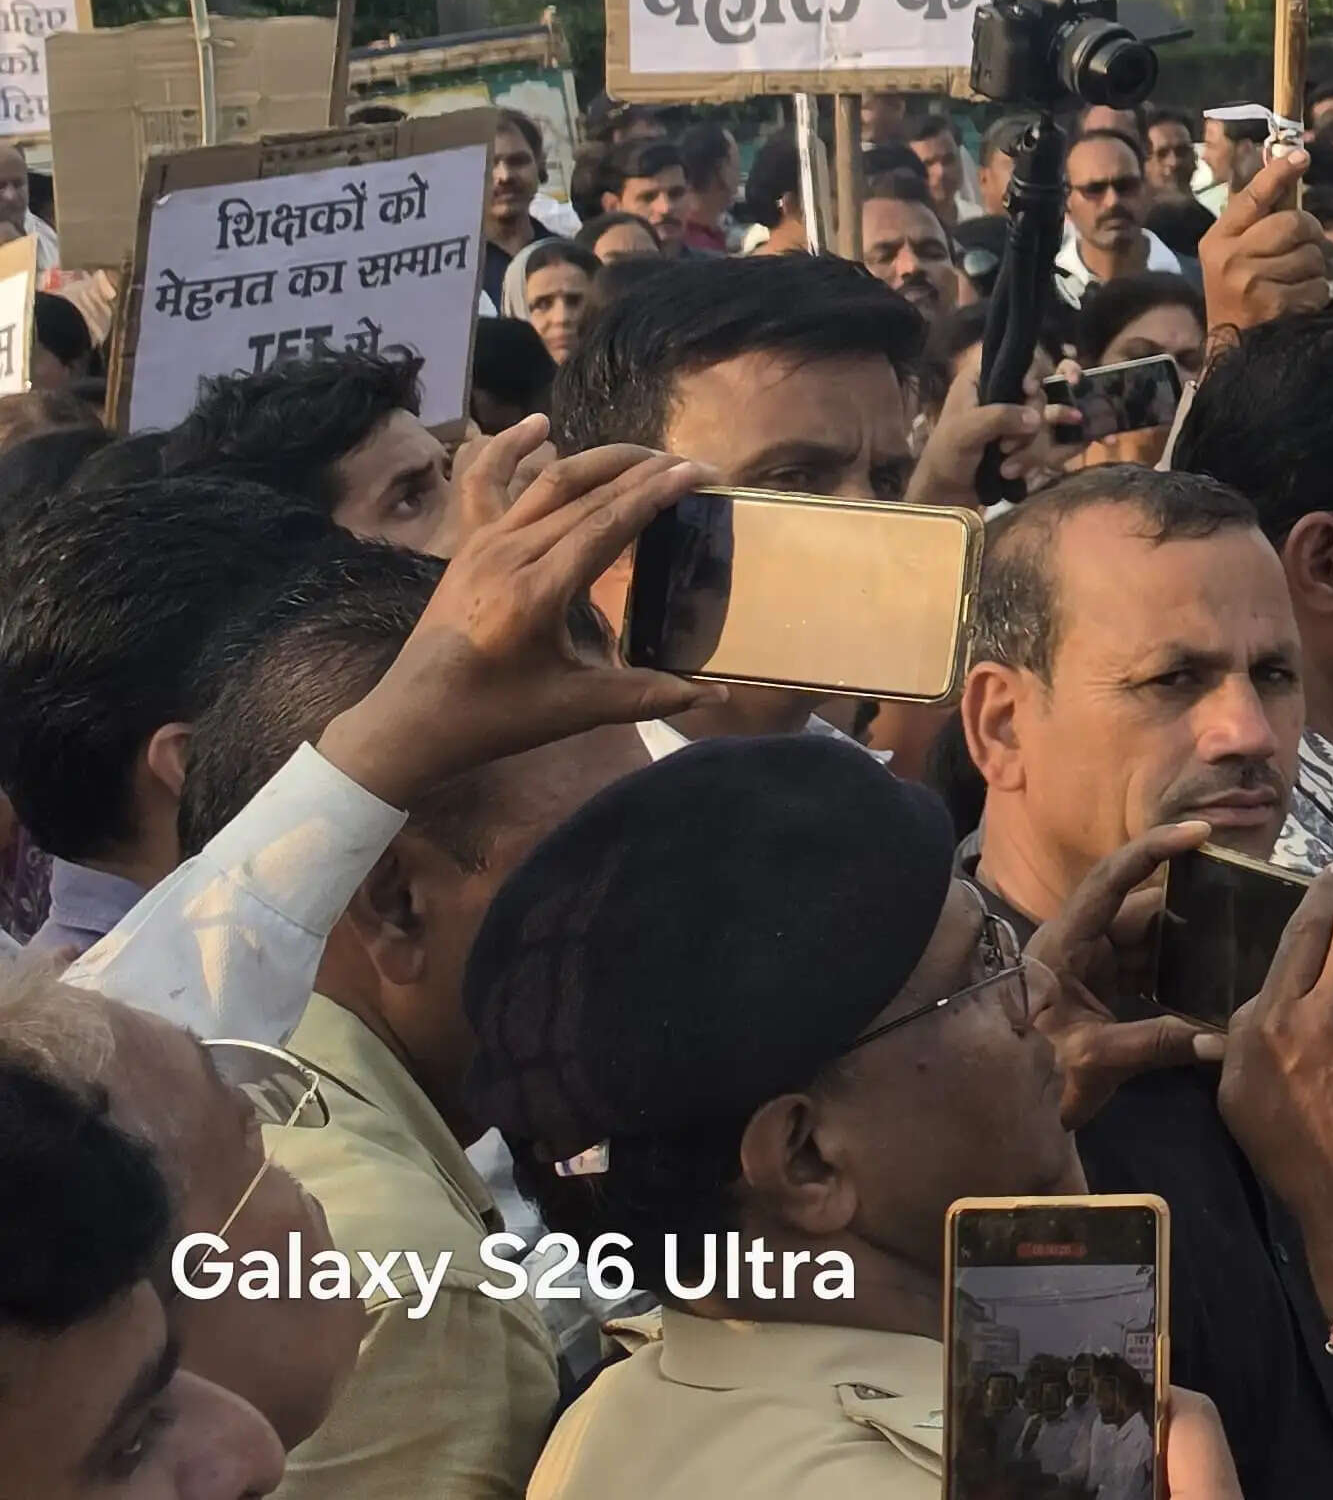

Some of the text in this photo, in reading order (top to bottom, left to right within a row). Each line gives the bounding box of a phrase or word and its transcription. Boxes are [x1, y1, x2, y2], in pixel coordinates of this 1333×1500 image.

[216, 172, 429, 250] शिक्षकों को
[155, 235, 470, 321] मेहनत का सम्मान
